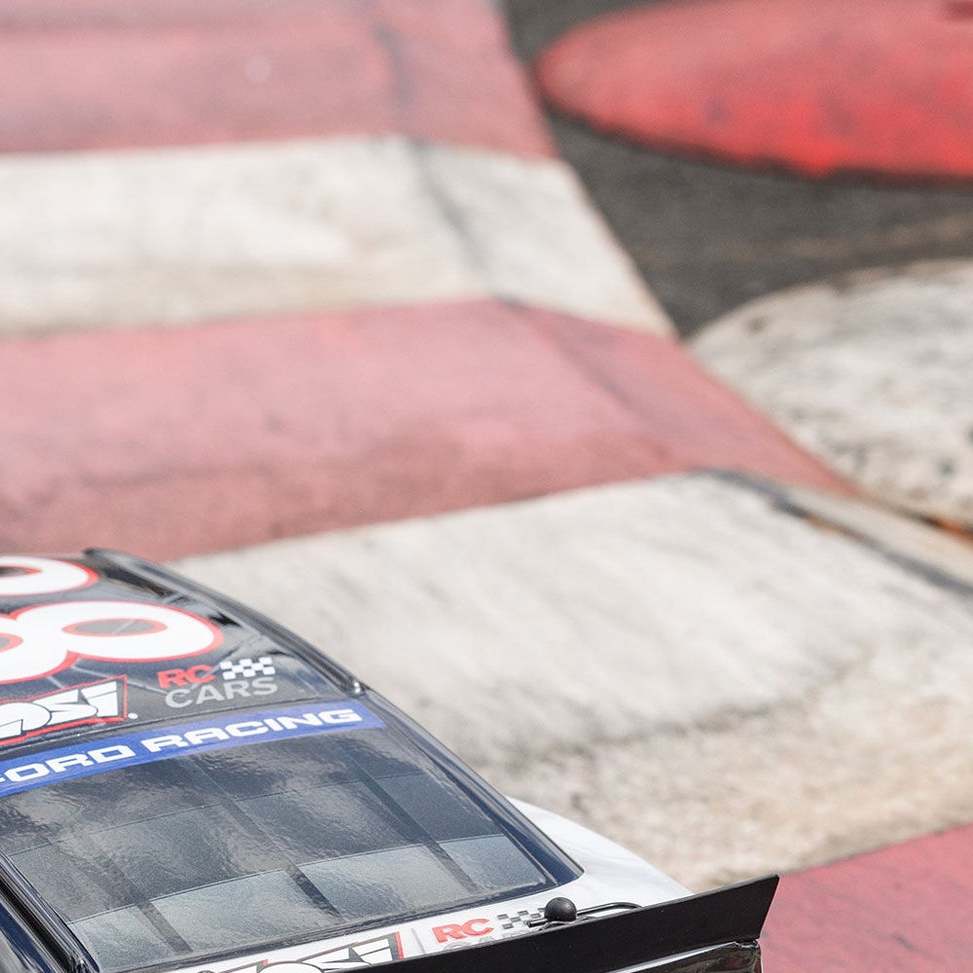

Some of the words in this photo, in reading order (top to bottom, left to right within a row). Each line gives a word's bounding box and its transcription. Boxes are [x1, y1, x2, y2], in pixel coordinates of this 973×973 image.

[157, 664, 217, 689] RC
[164, 676, 278, 709] CARS
[139, 708, 363, 751] RACING
[432, 918, 494, 944] RC
